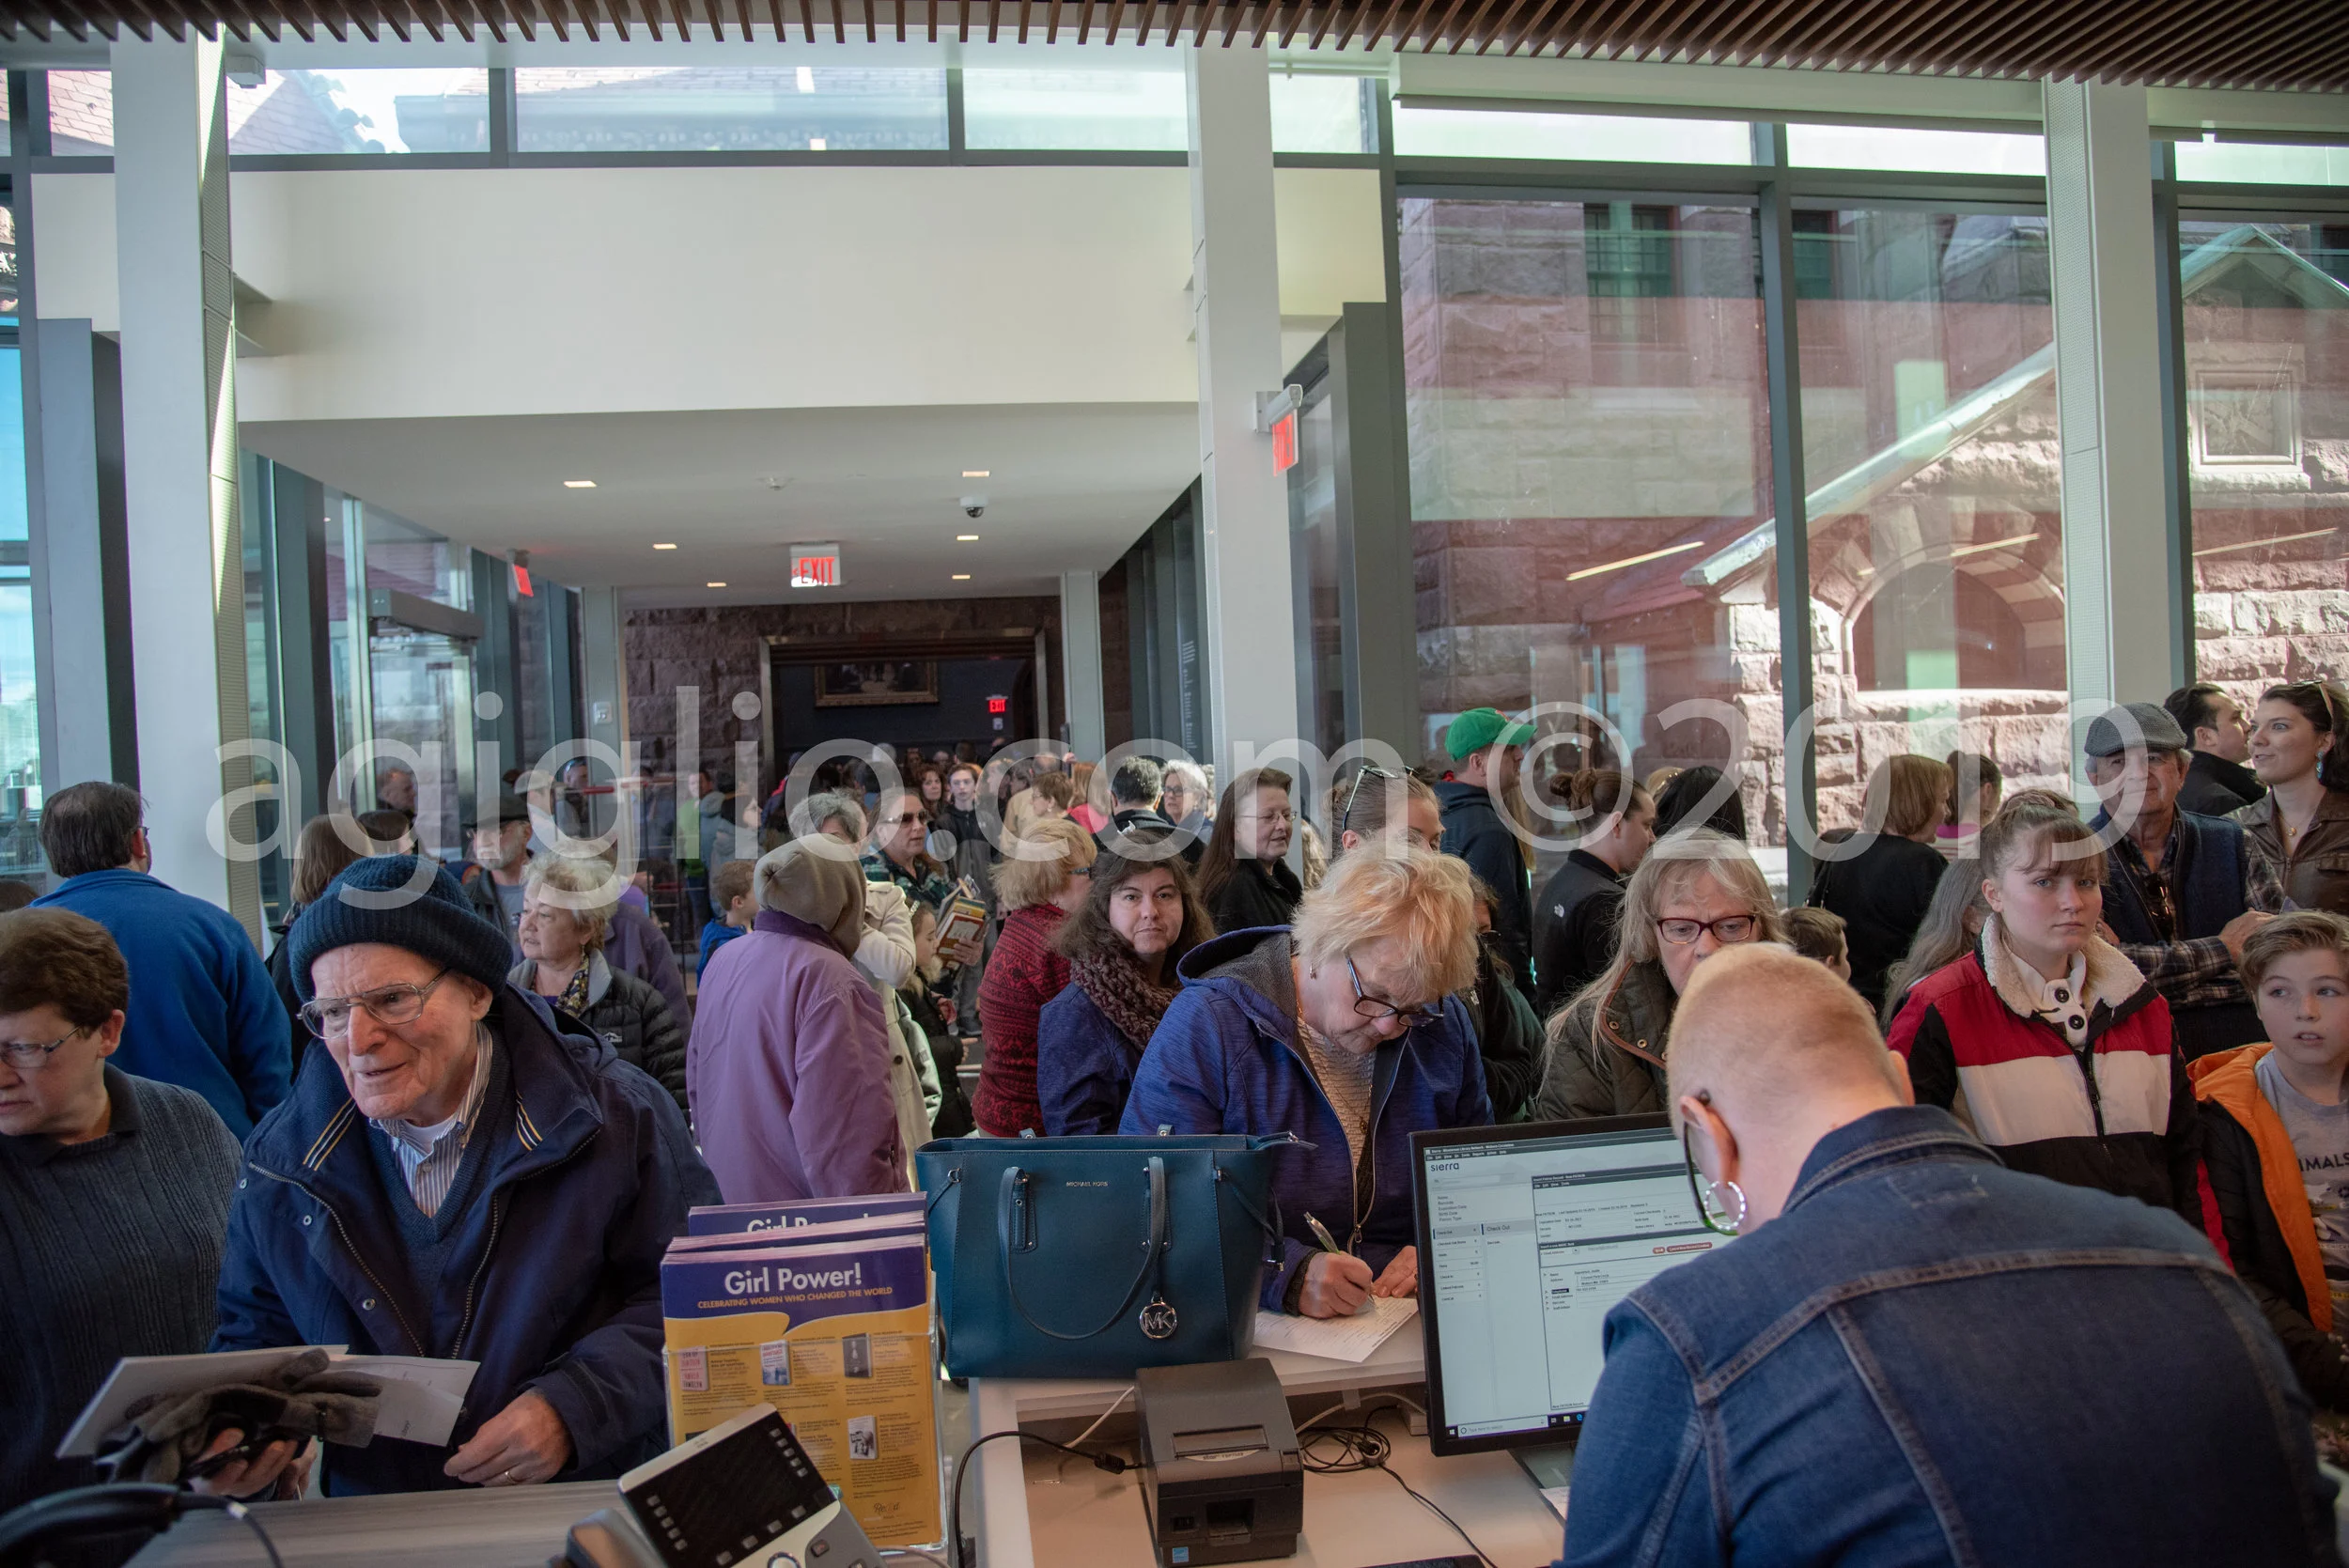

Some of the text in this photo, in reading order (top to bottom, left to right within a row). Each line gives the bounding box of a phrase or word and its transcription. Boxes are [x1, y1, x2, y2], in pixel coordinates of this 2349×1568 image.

[799, 556, 835, 585] EXIT
[989, 698, 1005, 713] EXIT
[1430, 1162, 1459, 1172] sierra
[2298, 1152, 2349, 1172] IMALS
[747, 1216, 786, 1233] Gil
[724, 1262, 863, 1295] Girl Power!
[697, 1286, 893, 1310] CELEBRATING WOMEN WHO CHANGED THE WORLD
[1144, 1312, 1174, 1330] MK
